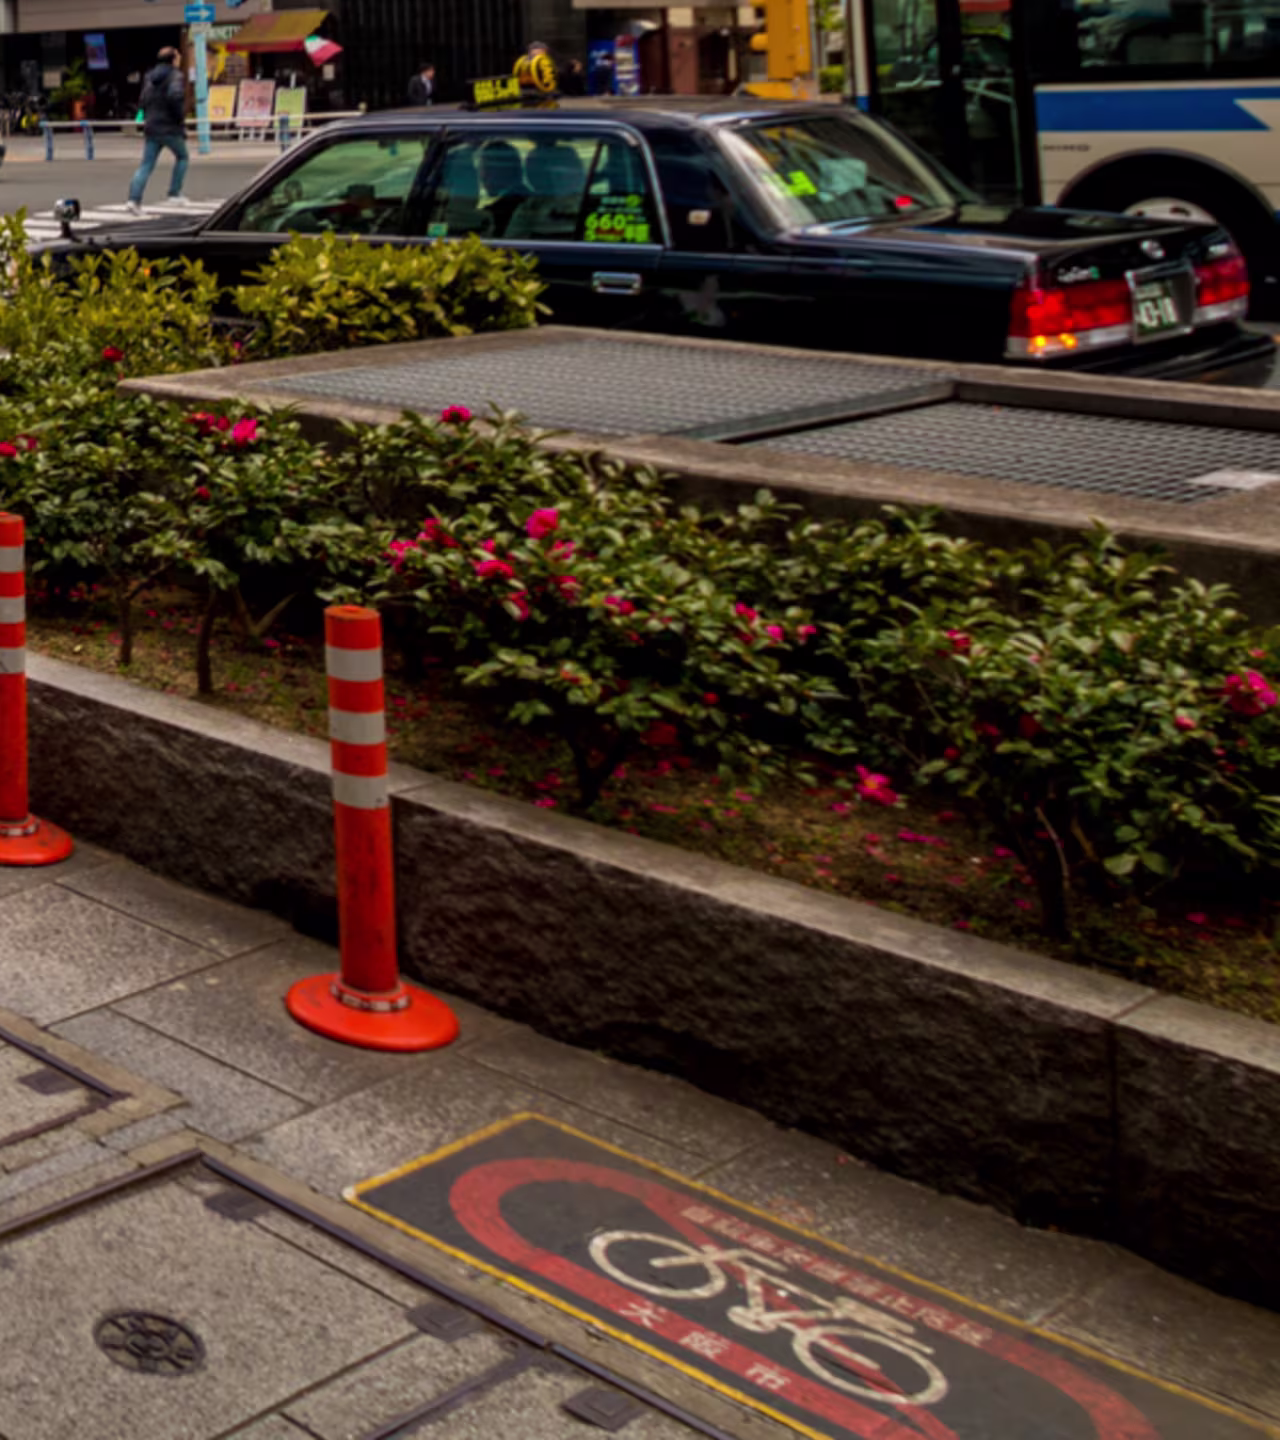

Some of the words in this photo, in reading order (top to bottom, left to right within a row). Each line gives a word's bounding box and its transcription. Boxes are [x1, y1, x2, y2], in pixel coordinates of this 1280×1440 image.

[585, 213, 626, 230] 660
[619, 1300, 791, 1392] 大阪市
